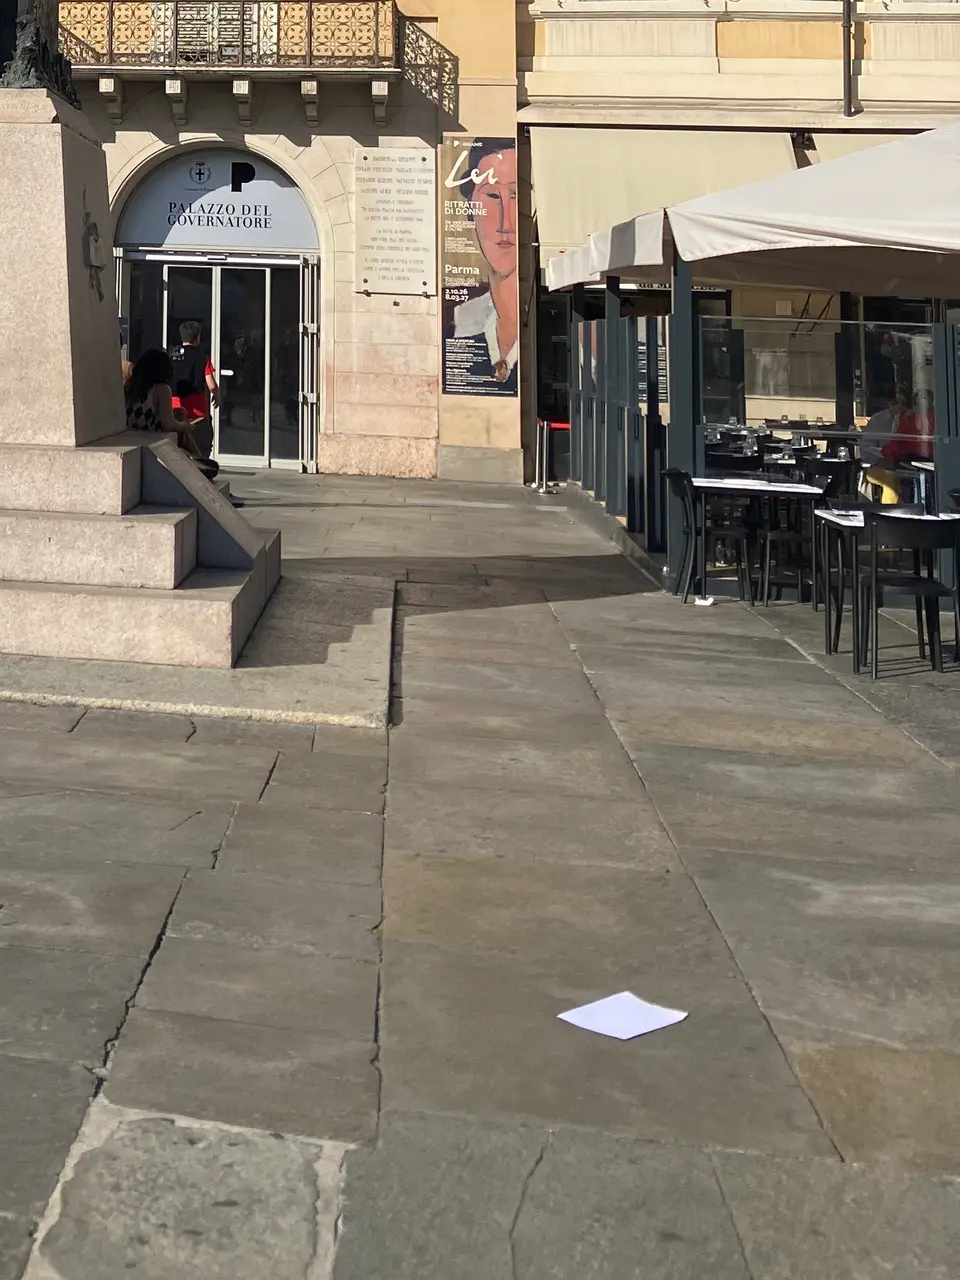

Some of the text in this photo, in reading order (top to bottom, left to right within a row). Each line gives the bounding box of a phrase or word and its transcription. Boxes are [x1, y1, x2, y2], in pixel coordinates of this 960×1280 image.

[445, 150, 502, 188] Lei
[231, 162, 256, 192] P
[168, 203, 272, 216] PALAZZO DEL
[168, 214, 272, 229] GOVERNATORE
[445, 265, 479, 274] Parma
[445, 294, 468, 302] 8.03.27
